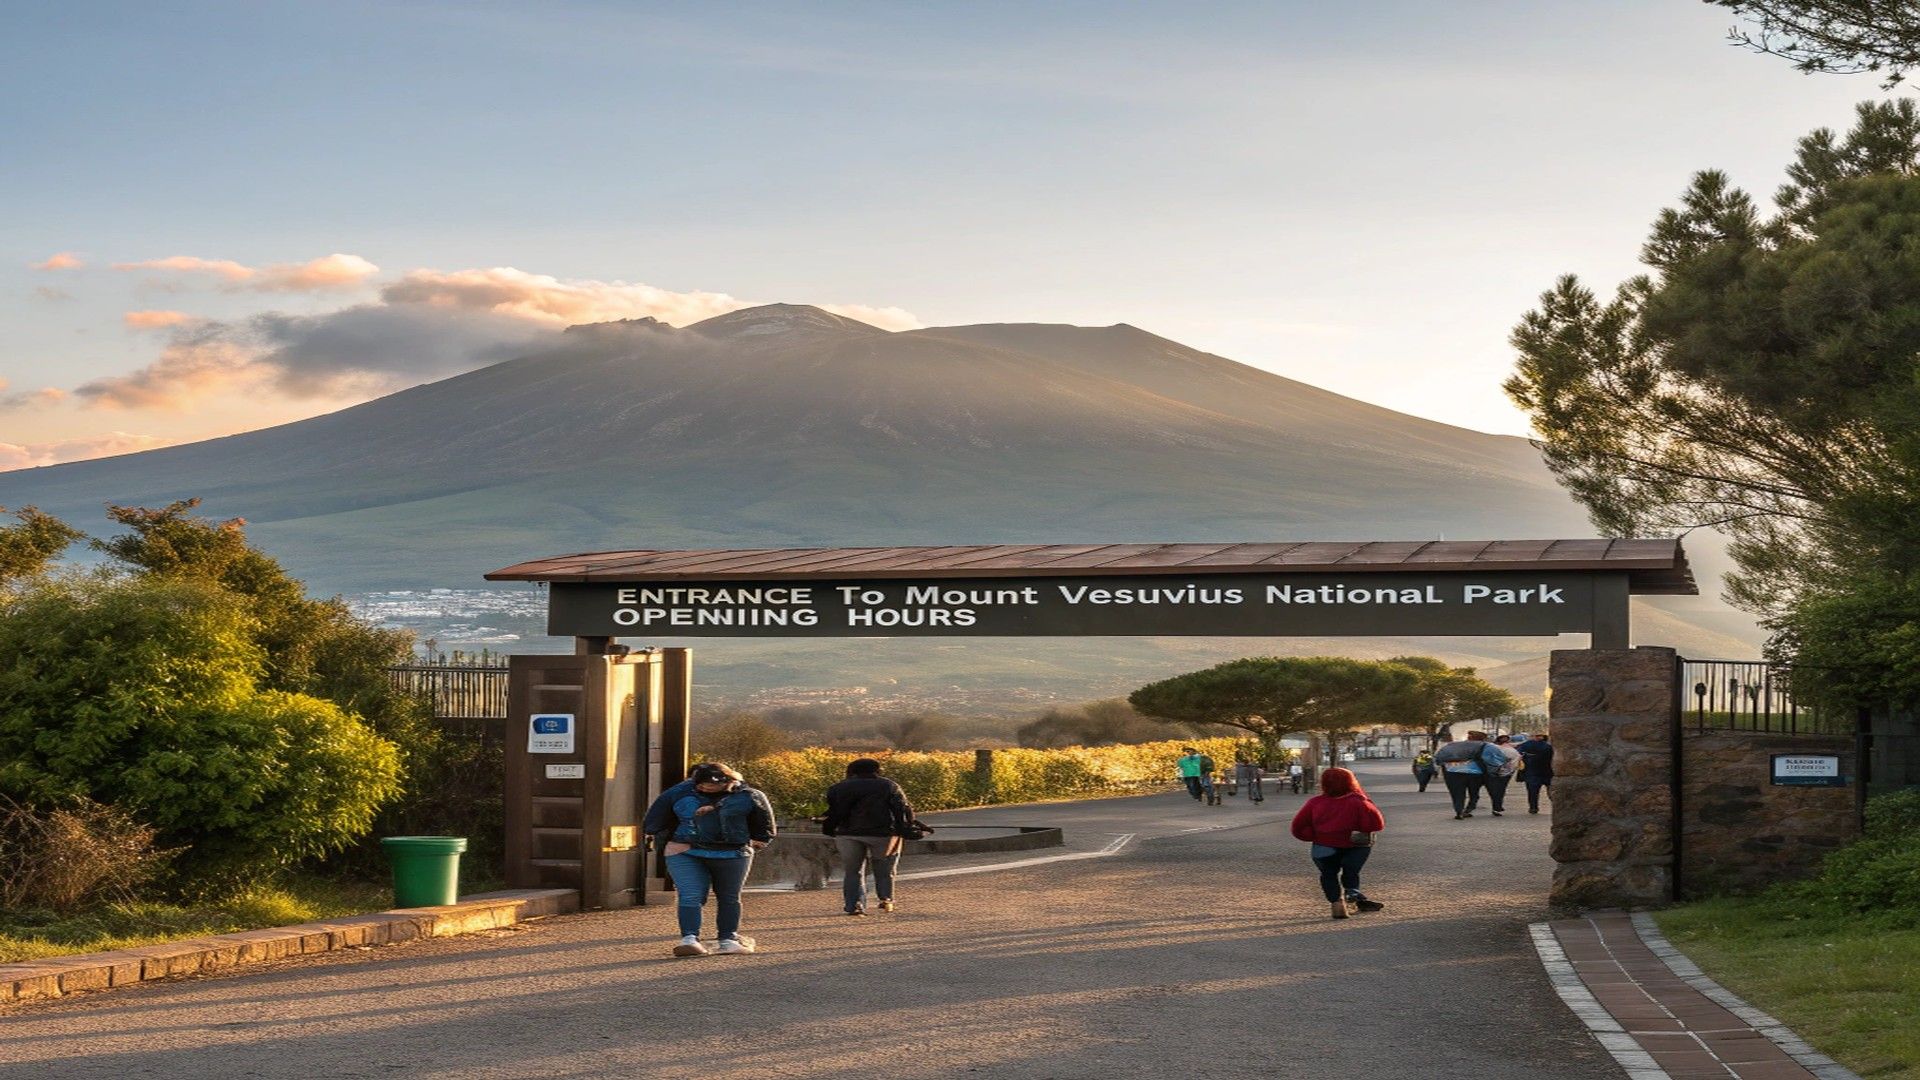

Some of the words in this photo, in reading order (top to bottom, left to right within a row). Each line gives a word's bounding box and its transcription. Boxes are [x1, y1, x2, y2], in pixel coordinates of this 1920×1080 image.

[617, 588, 813, 605] ENTRANCE
[835, 586, 886, 605] To
[905, 586, 1039, 605] Mount
[1058, 585, 1244, 605] Vesuvius
[1463, 584, 1566, 605] Park
[848, 608, 977, 627] HOURS
